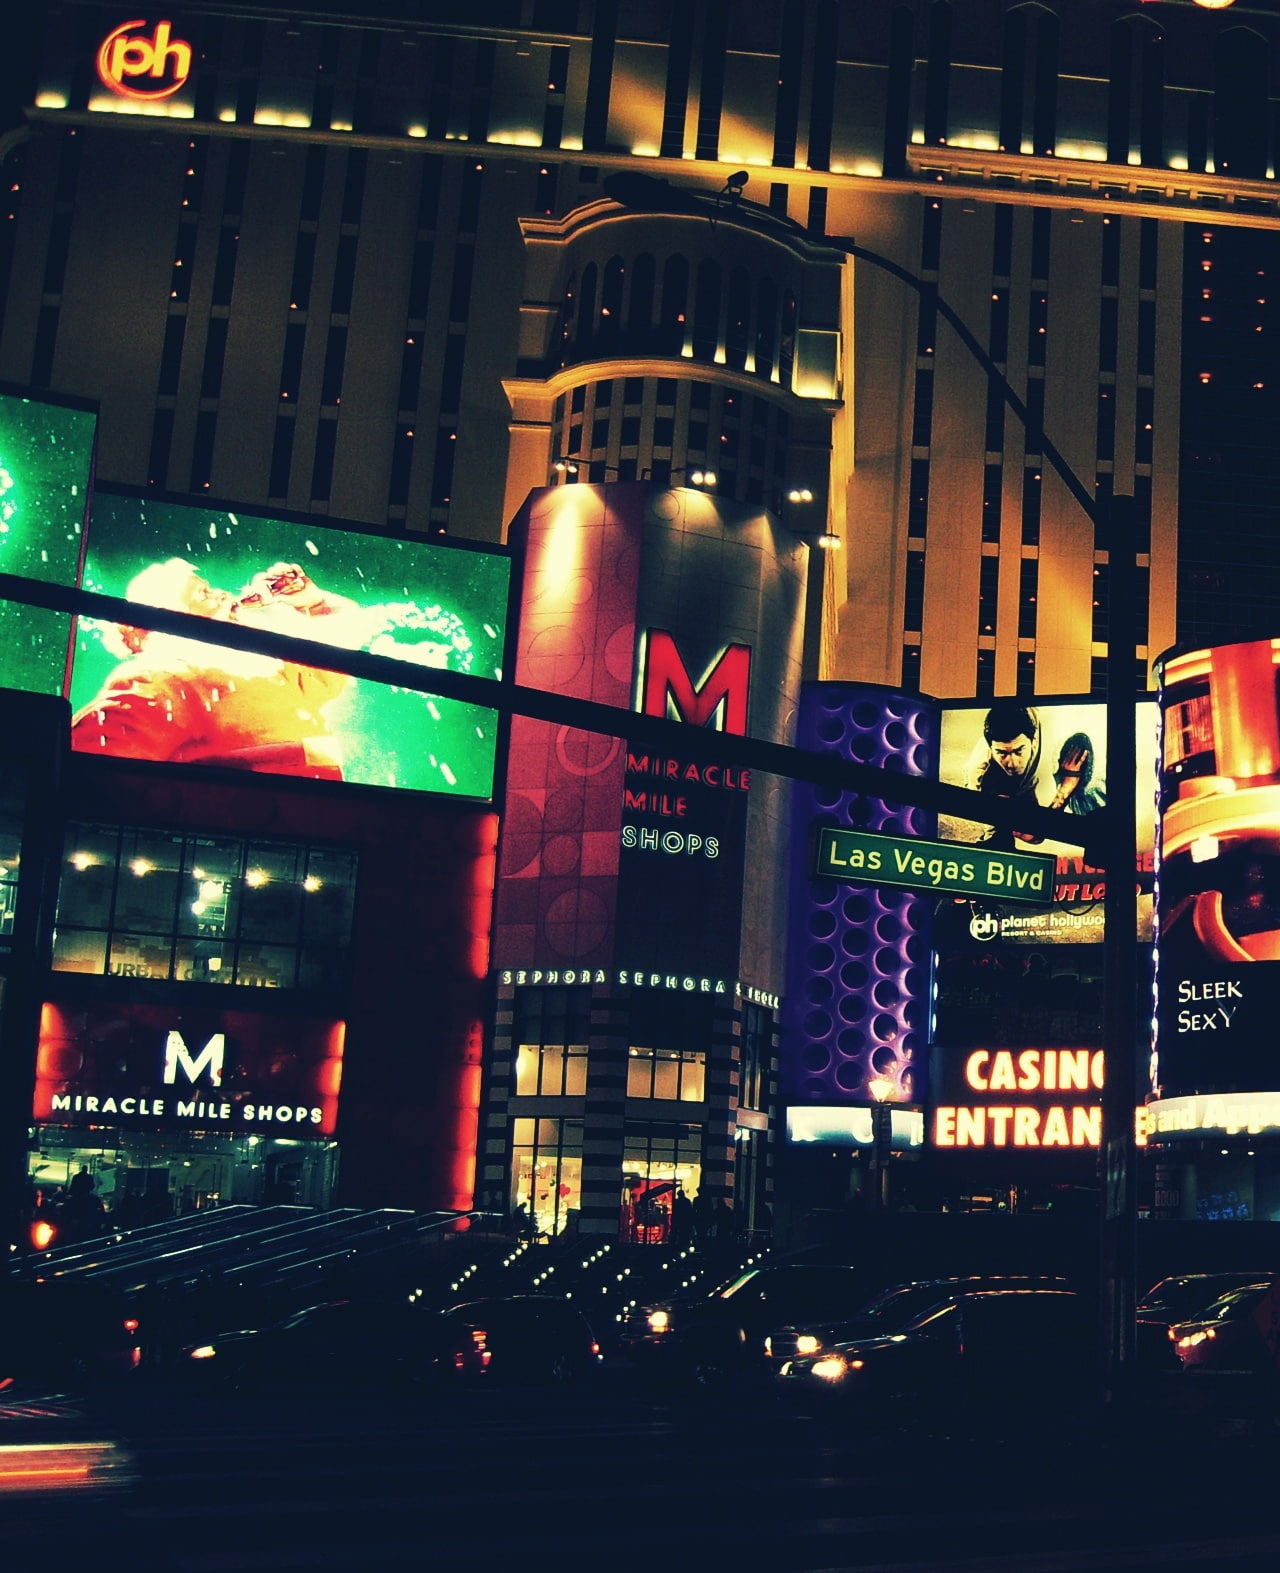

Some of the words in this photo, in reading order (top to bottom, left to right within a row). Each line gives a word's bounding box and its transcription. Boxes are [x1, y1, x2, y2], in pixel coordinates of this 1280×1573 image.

[108, 20, 191, 84] ph
[640, 628, 752, 737] M
[626, 753, 751, 790] MIRACLE
[623, 789, 687, 816] MILE
[622, 825, 719, 858] SHOPS
[829, 841, 882, 871] Las
[893, 848, 975, 885] Vegas
[987, 861, 1044, 891] Blvd
[972, 913, 998, 938] ph
[1001, 915, 1047, 930] planet
[1049, 913, 1105, 929] hollywo
[503, 970, 606, 985] SEPHORA
[619, 971, 726, 993] SEPHORA
[1178, 980, 1243, 1003] SLEEK
[163, 1031, 225, 1087] M
[51, 1094, 164, 1116] MIRACLE
[176, 1101, 231, 1119] MILE
[243, 1104, 322, 1124] SHOPS
[935, 1106, 1148, 1146] ENTRANE
